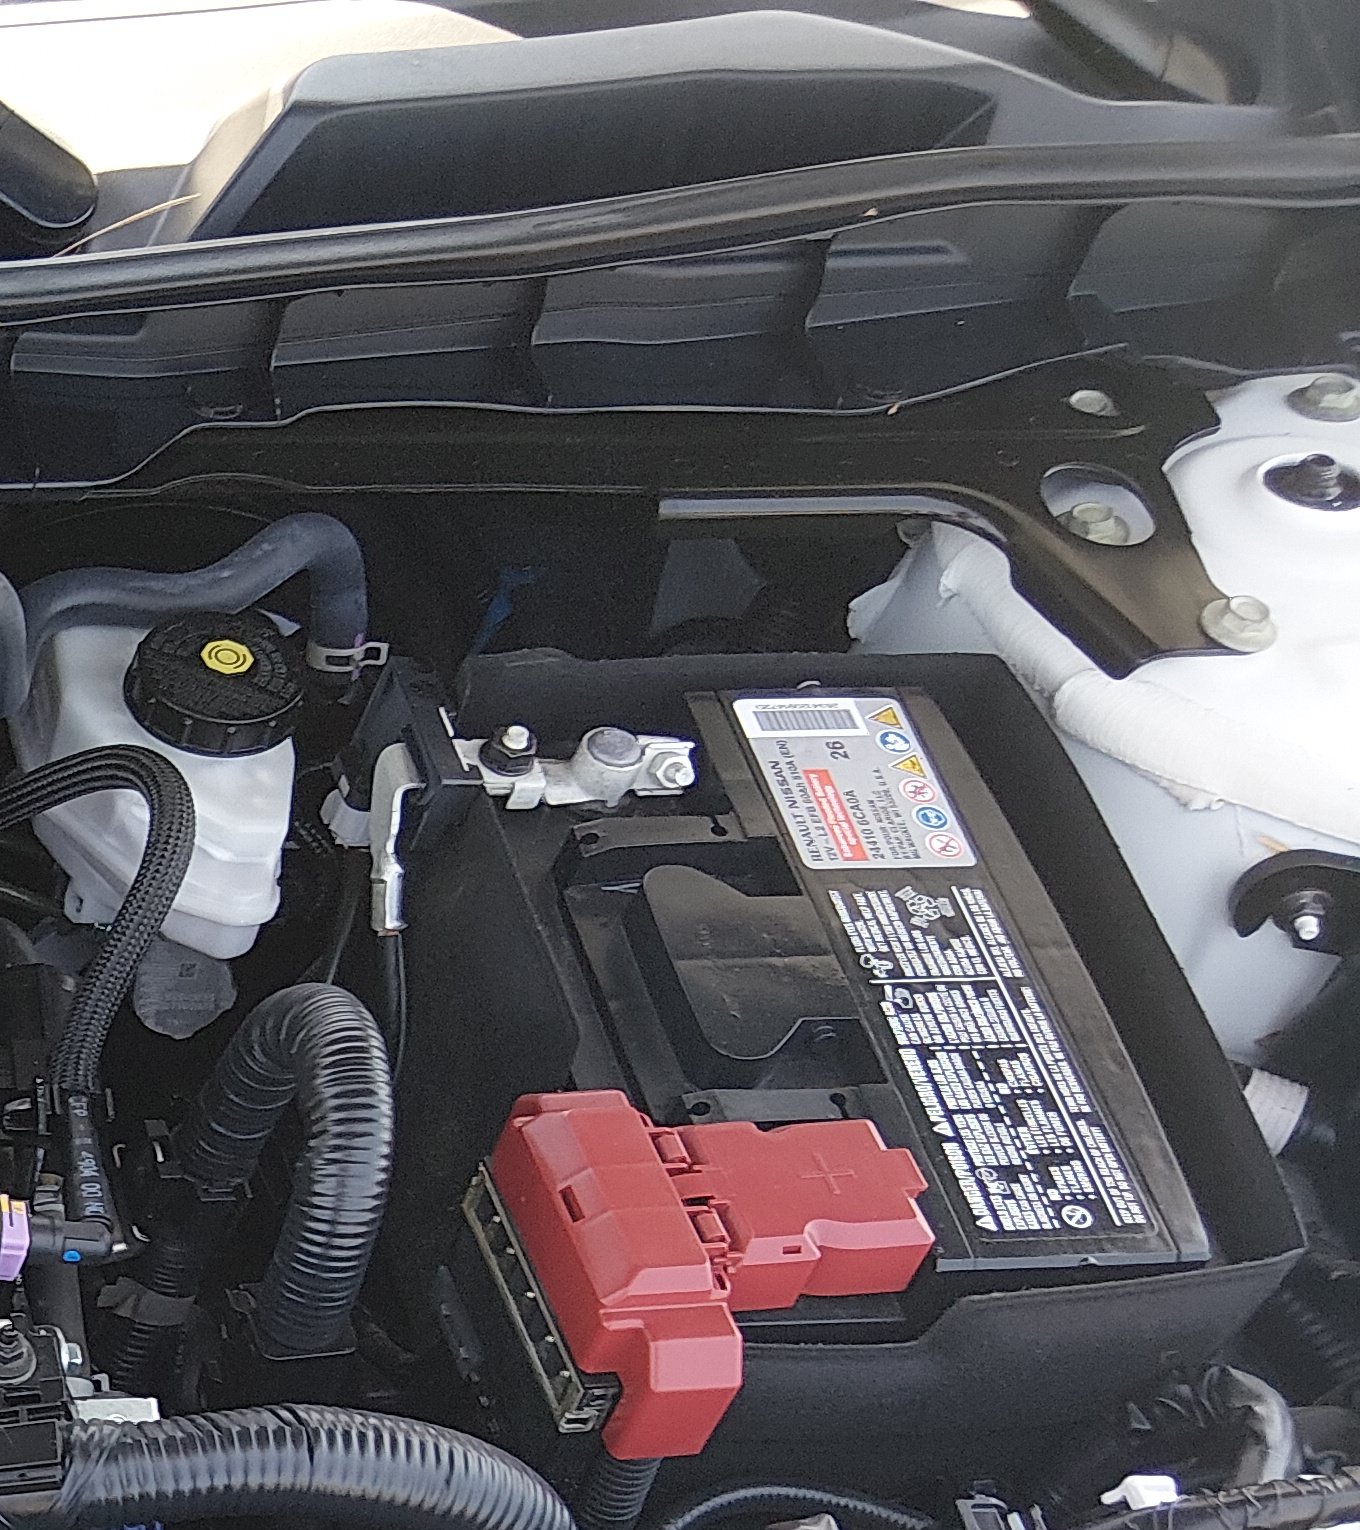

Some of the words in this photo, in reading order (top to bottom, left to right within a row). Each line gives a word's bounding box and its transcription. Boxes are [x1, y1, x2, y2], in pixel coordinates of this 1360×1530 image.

[824, 740, 850, 760] 26
[767, 760, 800, 808] NISSAN
[791, 812, 824, 861] RENAULT
